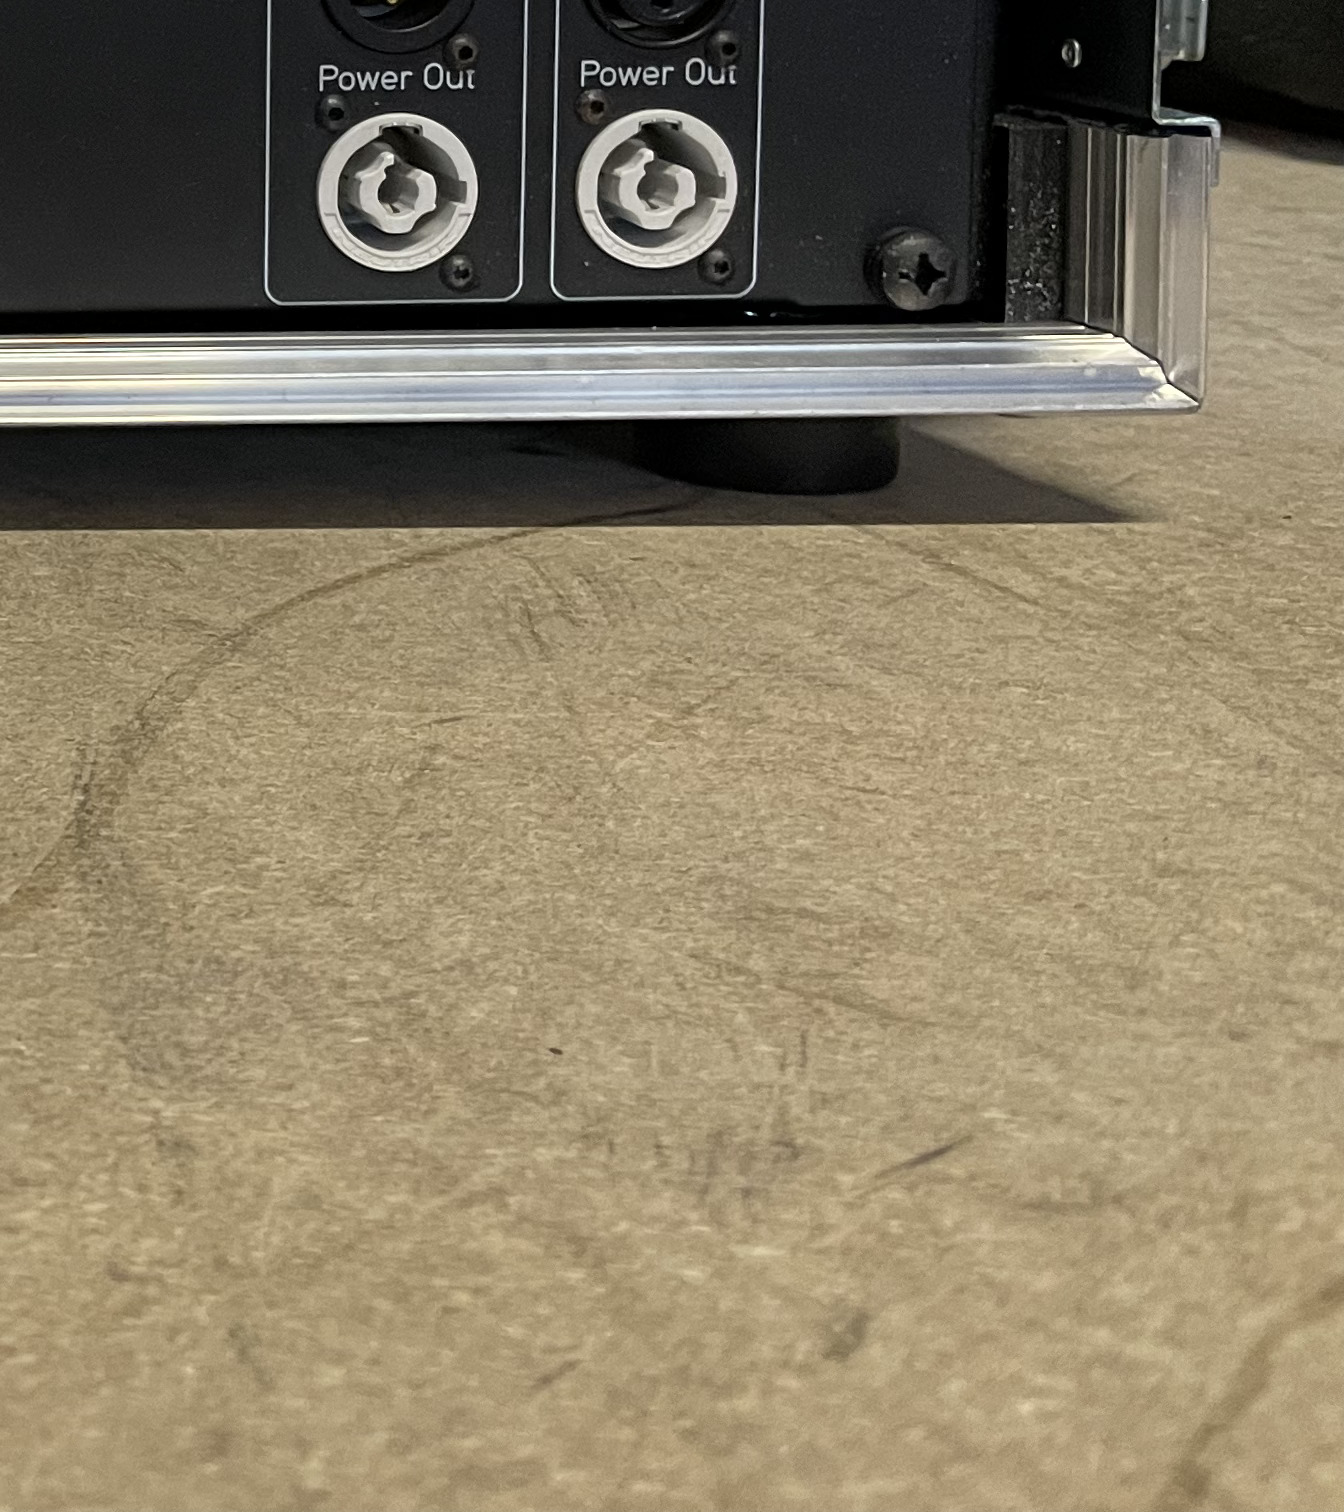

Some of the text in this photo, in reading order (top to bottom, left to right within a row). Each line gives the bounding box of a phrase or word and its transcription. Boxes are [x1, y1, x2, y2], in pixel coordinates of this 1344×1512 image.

[319, 62, 475, 92] Power Out
[580, 57, 736, 88] Power Out
